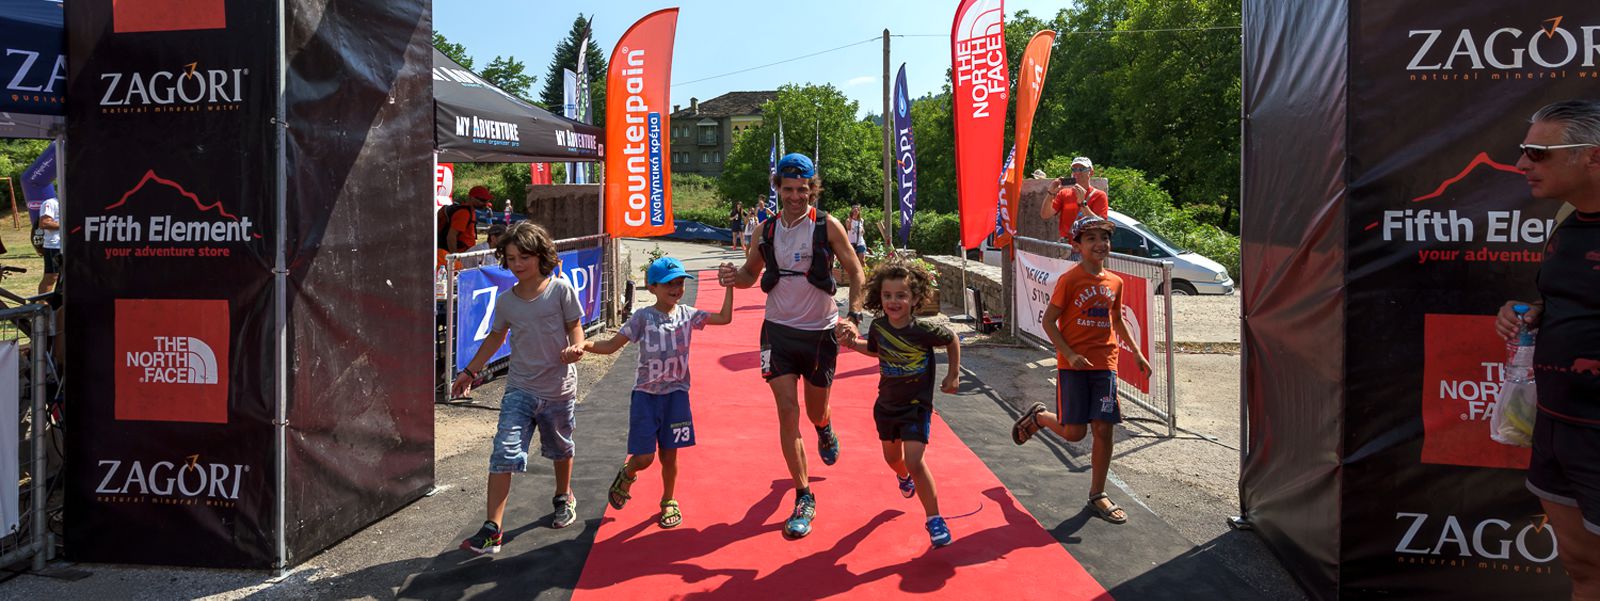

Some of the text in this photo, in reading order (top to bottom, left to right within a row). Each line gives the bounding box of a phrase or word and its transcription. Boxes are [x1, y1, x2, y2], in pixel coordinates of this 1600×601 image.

[957, 41, 972, 86] THE
[986, 34, 1006, 94] FACE
[971, 37, 990, 118] NORTH
[1410, 72, 1478, 80] natural
[1491, 71, 1566, 80] mineral
[100, 68, 243, 106] ZAGORI
[102, 106, 148, 114] natural
[456, 115, 469, 137] MY
[622, 49, 649, 227] Counterpain
[84, 215, 252, 242] Fifth Element
[1383, 209, 1474, 241] Fifth
[105, 245, 230, 259] your adventure store
[1418, 249, 1459, 264] your
[1025, 266, 1049, 286] NEVER
[1032, 287, 1050, 305] STOP
[153, 336, 188, 352] THE
[644, 321, 691, 353] CITY
[126, 352, 188, 367] NORTH
[648, 354, 689, 382] BOY
[144, 368, 188, 383] FACE
[1439, 380, 1502, 401] NOR
[672, 426, 690, 443] 73
[96, 460, 243, 499] ZAGORI
[1398, 556, 1551, 574] natural mineral
